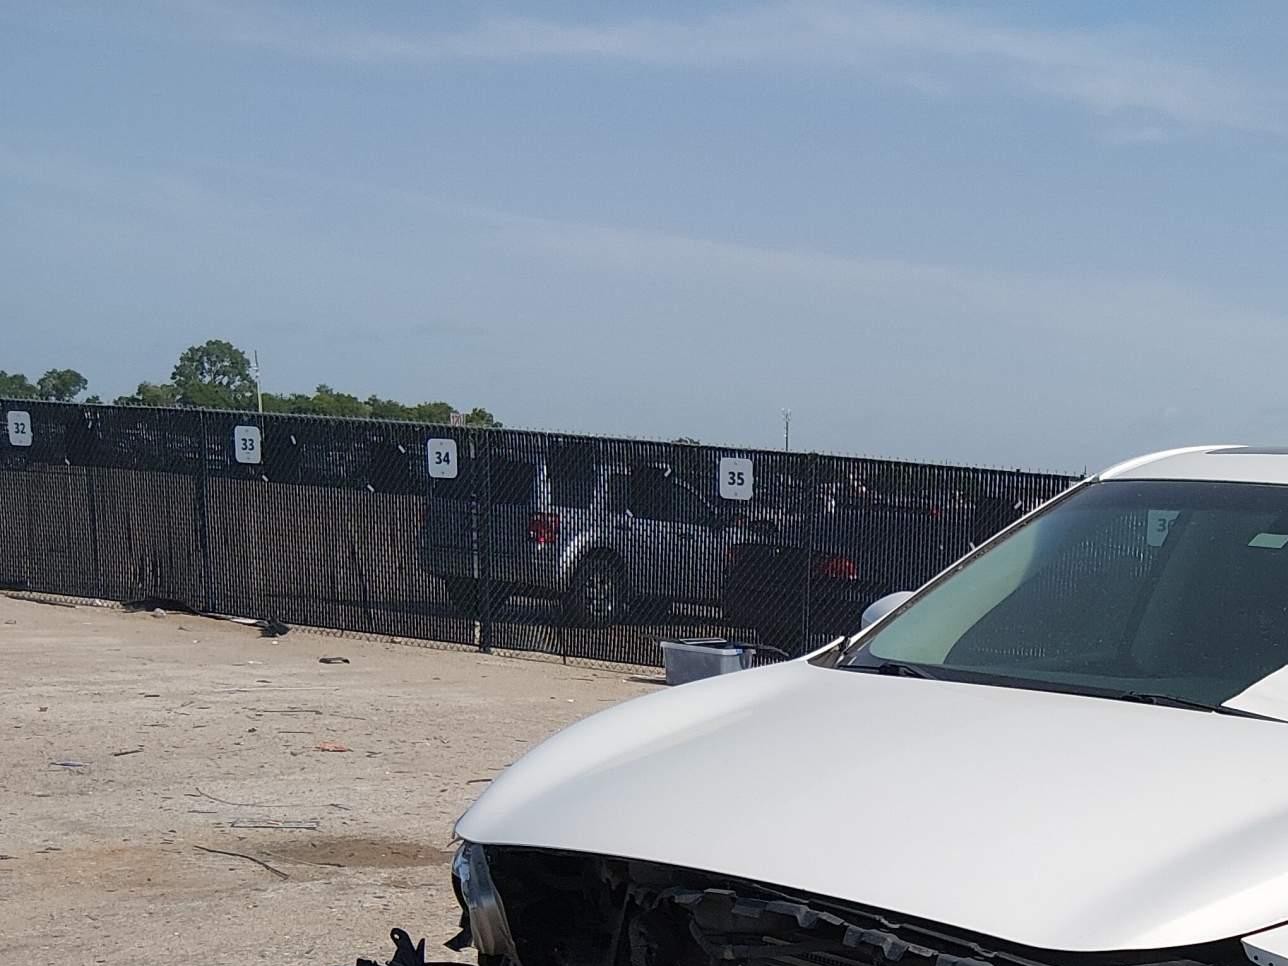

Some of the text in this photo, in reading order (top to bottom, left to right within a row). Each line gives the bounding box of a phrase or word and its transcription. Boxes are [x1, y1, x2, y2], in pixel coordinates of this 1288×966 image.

[14, 422, 26, 434] 32
[241, 438, 255, 451] 33
[435, 451, 450, 465] 34
[728, 471, 745, 486] 35
